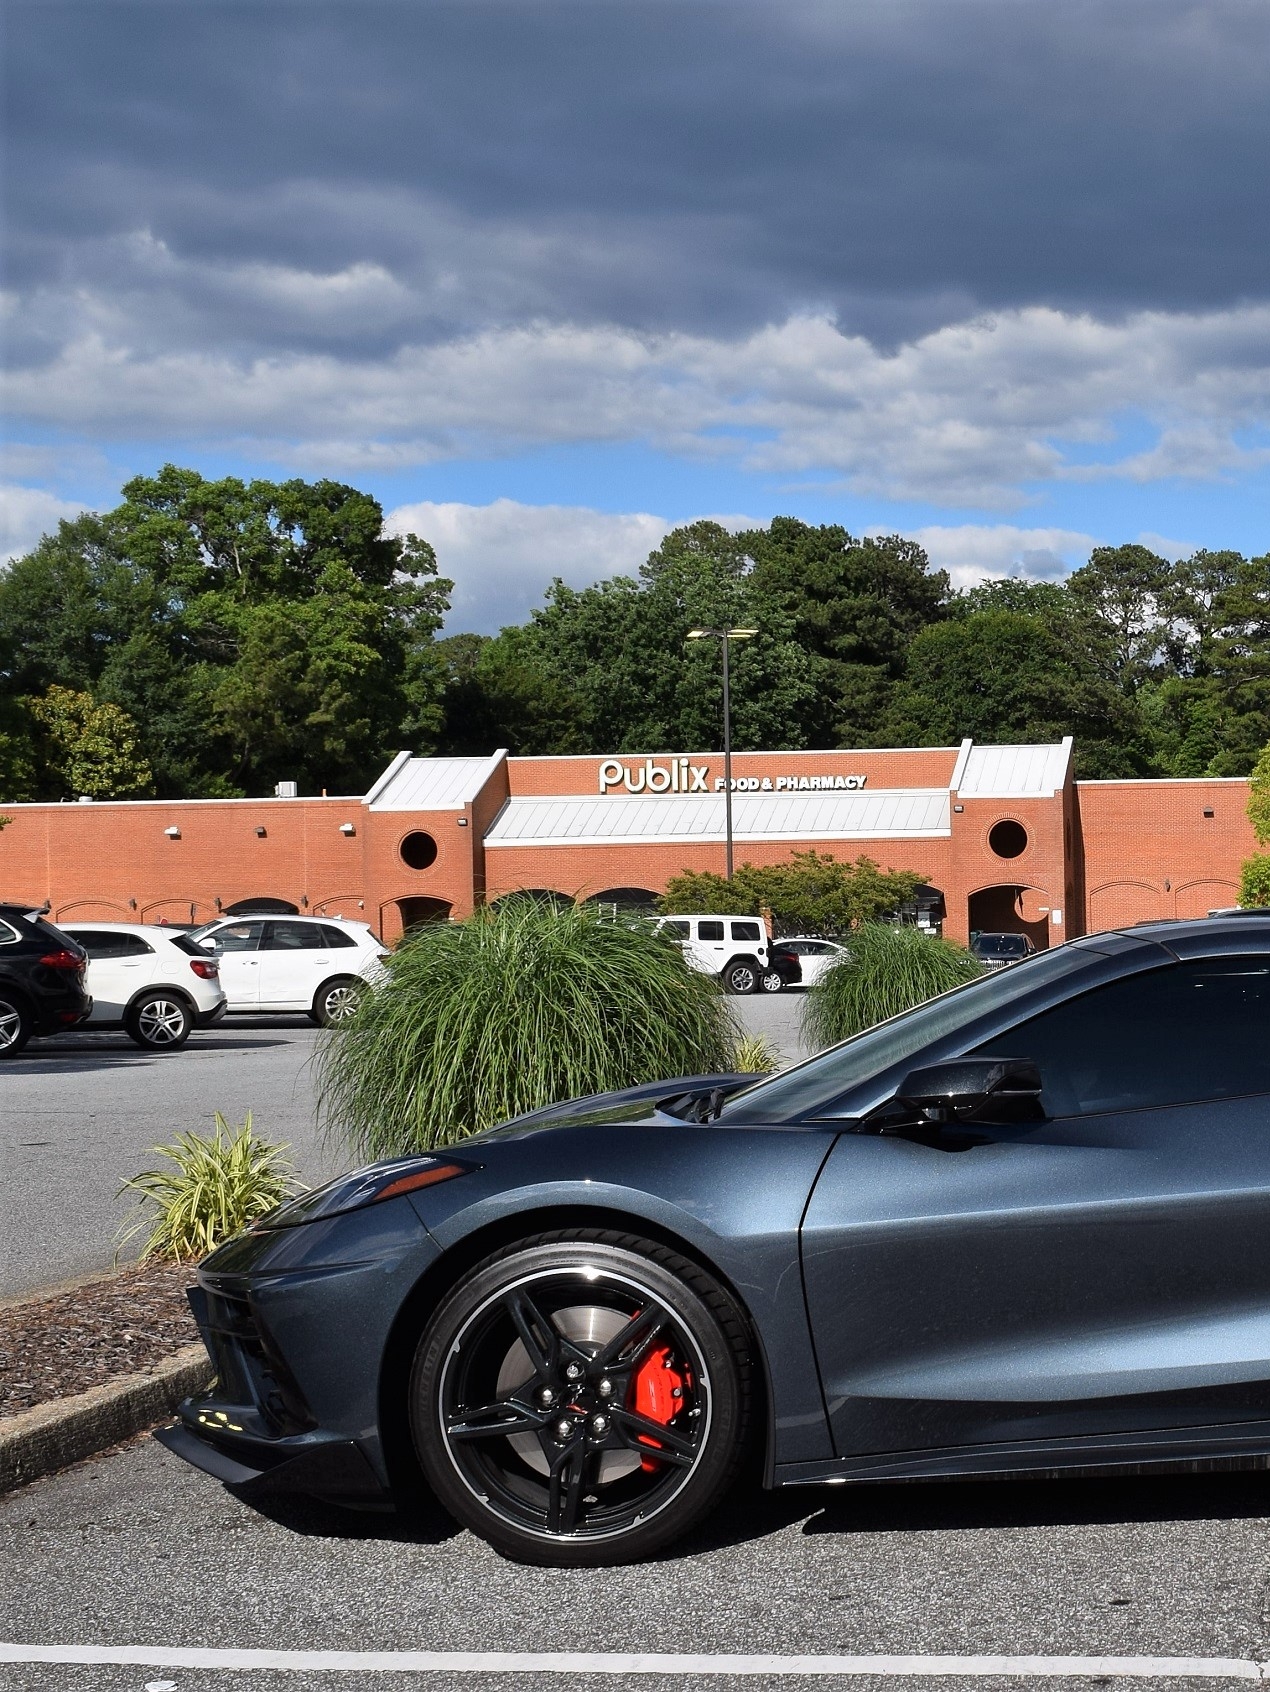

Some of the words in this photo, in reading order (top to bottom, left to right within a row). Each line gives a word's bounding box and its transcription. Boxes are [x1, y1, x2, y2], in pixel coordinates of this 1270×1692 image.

[599, 758, 709, 793] Publix
[714, 777, 760, 791] FOOD
[761, 777, 773, 790] &
[776, 775, 867, 790] PHARMACY
